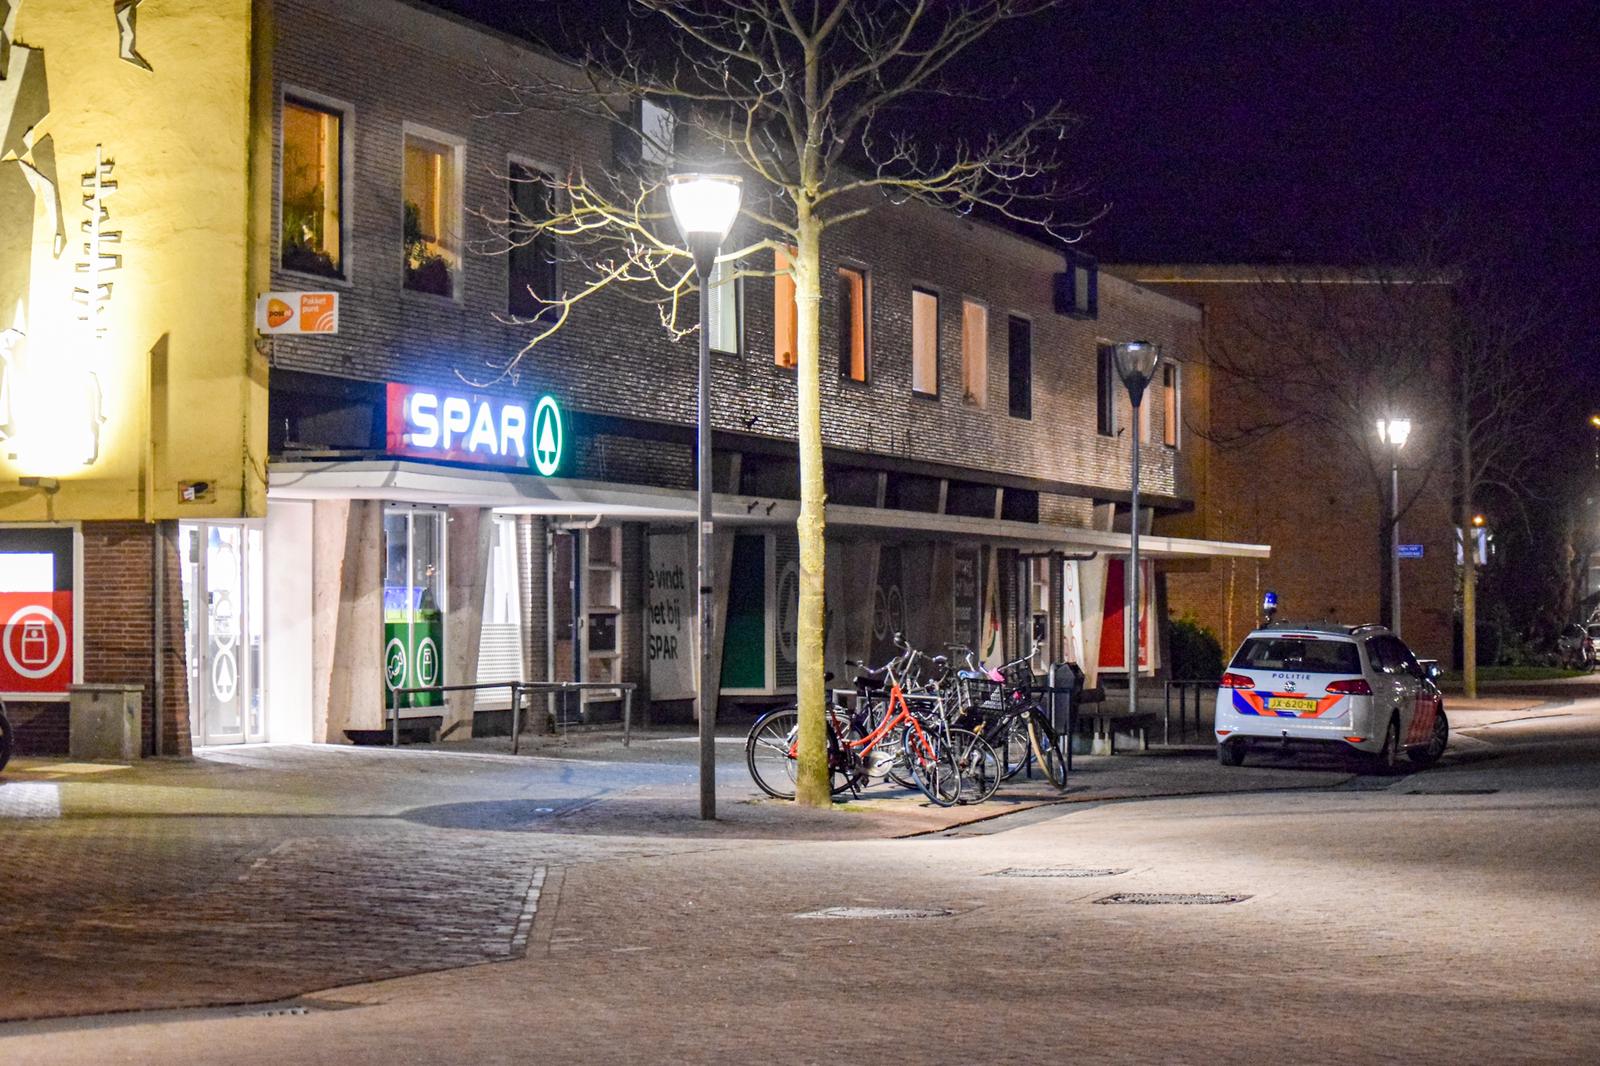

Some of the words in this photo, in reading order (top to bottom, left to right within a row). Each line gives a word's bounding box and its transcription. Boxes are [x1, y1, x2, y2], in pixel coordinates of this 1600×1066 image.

[410, 392, 527, 458] SPAR
[657, 563, 685, 590] vindt
[667, 599, 681, 631] bij
[649, 635, 678, 660] SPAR
[1272, 673, 1312, 681] POLITIE
